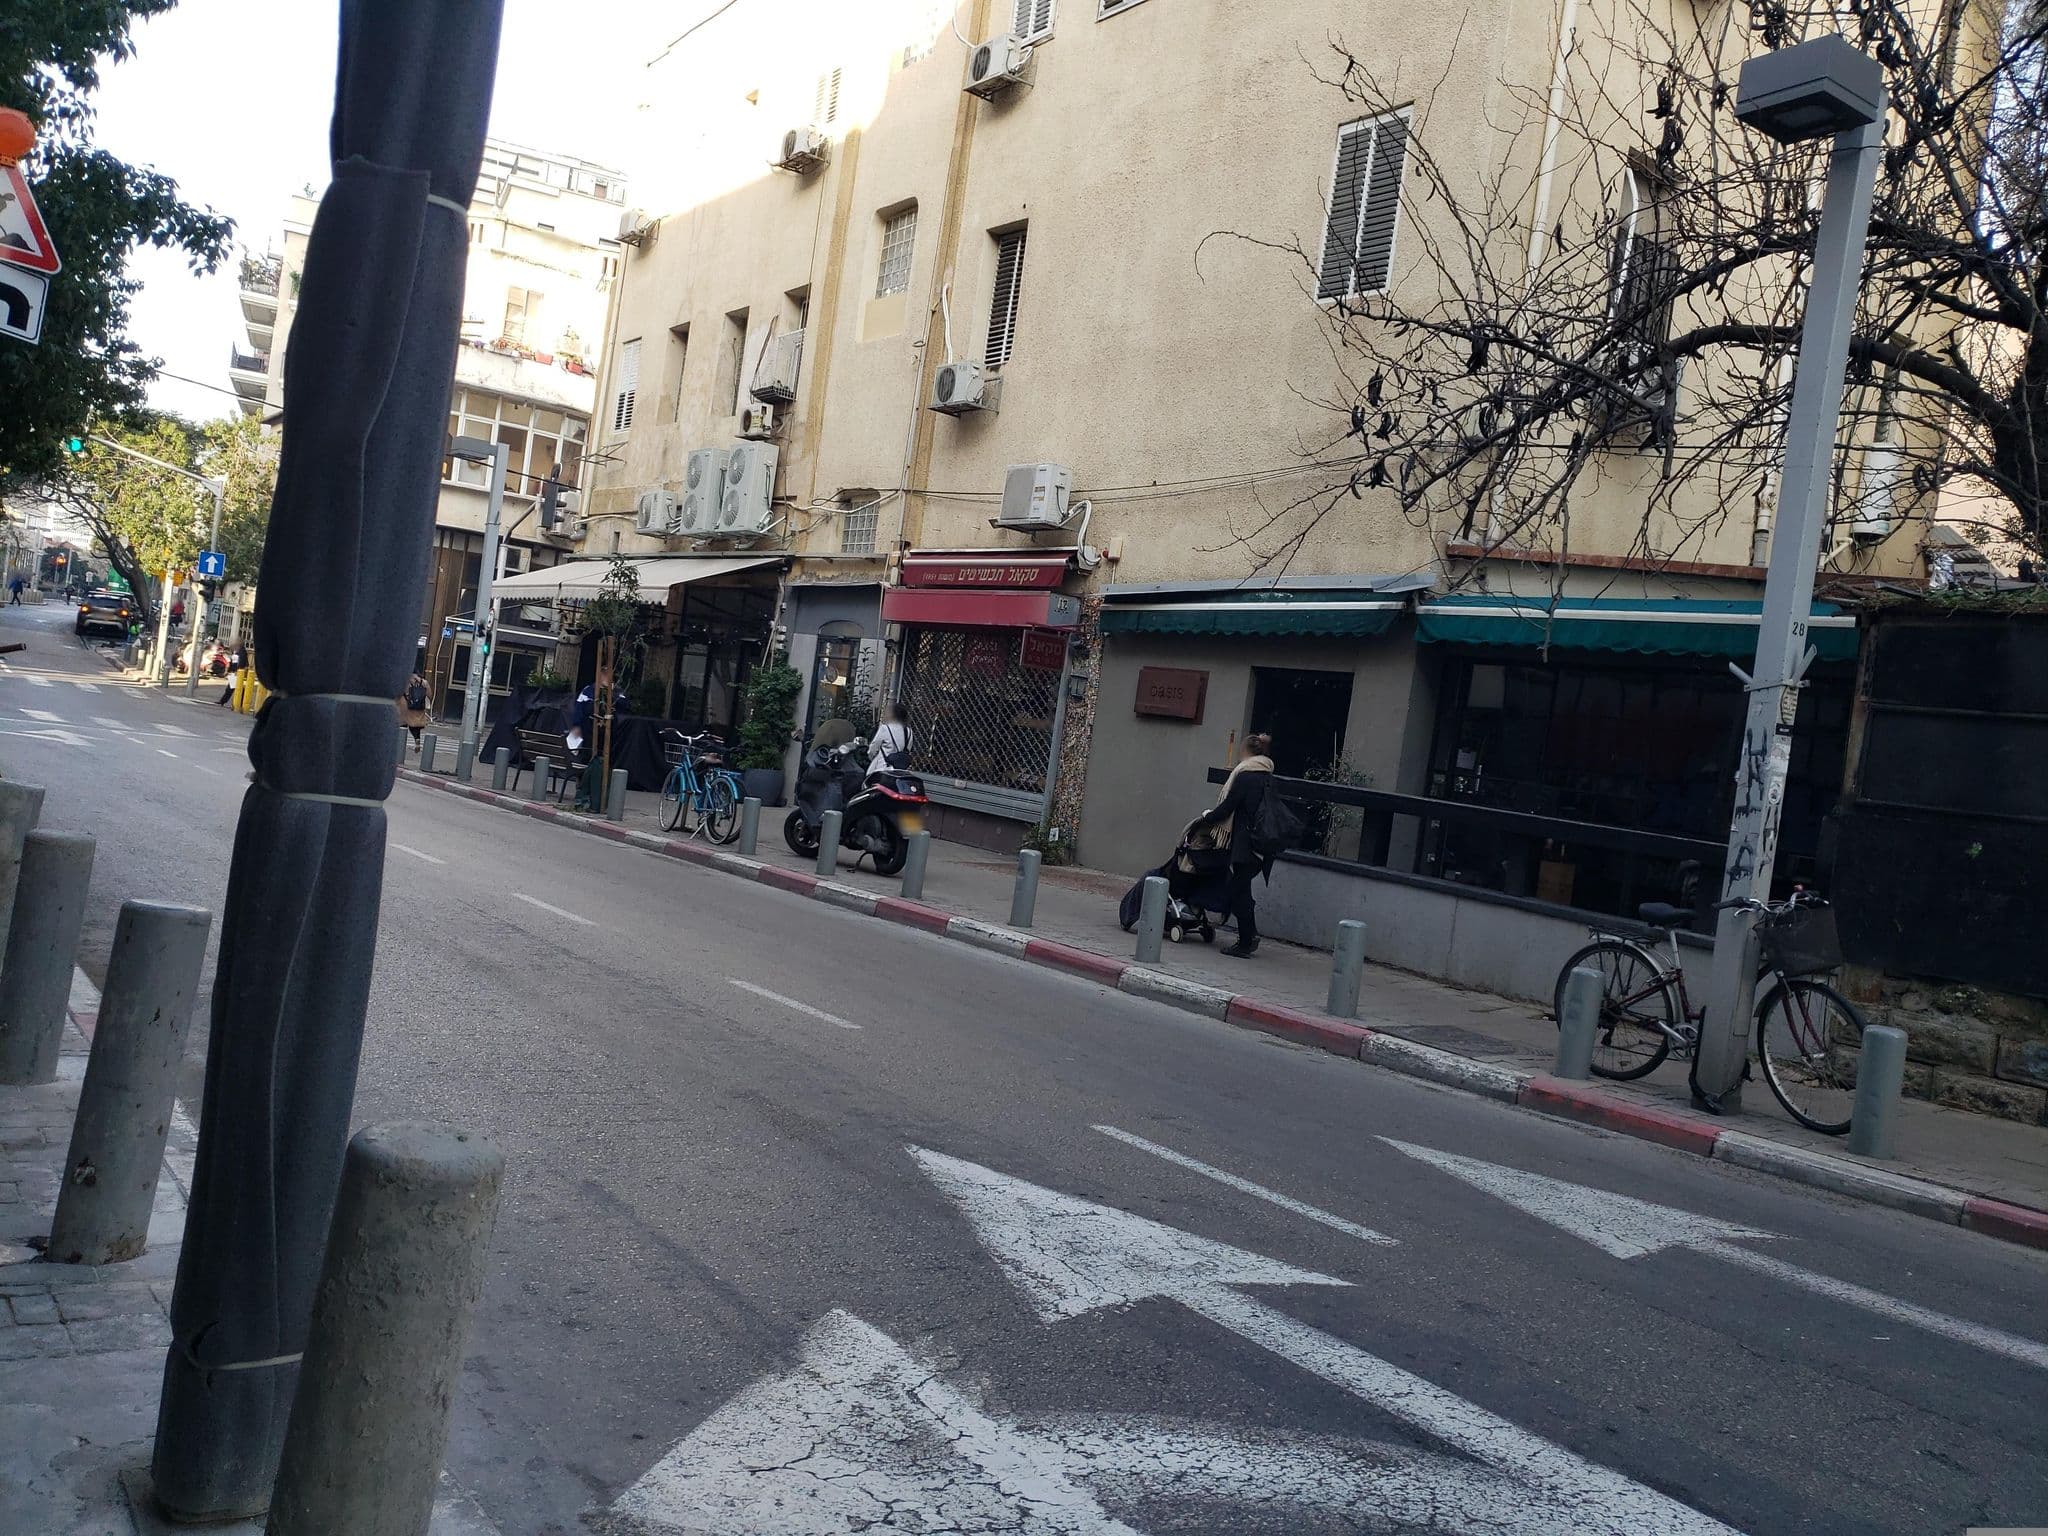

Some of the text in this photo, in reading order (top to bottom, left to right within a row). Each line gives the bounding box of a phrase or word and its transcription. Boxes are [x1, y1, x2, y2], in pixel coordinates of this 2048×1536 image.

[958, 567, 1004, 581] תכשיטים
[1008, 566, 1039, 584] סקאל
[1792, 621, 1805, 637] 28
